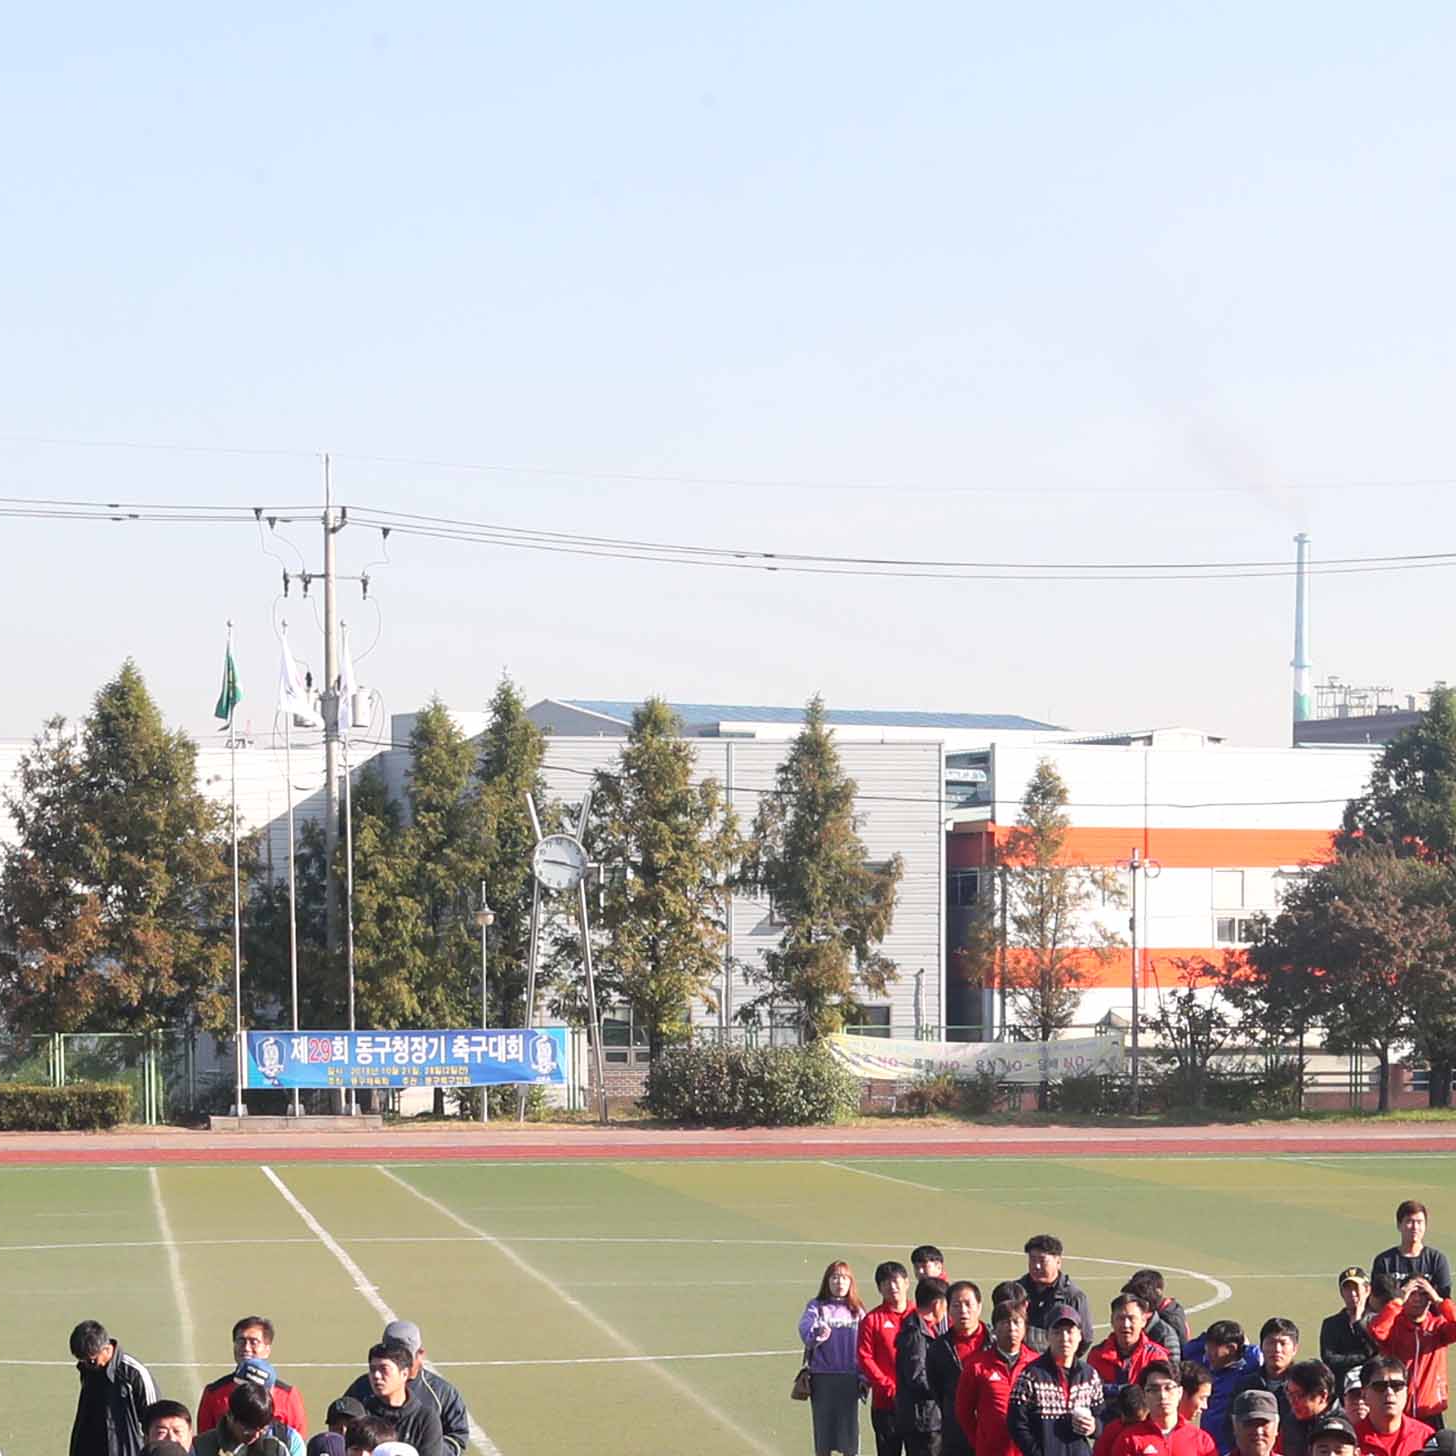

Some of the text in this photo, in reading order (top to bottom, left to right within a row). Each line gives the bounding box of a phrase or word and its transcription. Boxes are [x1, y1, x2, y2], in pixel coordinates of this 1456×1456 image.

[290, 1034, 524, 1065] 제29회 동구청장기 축구대회
